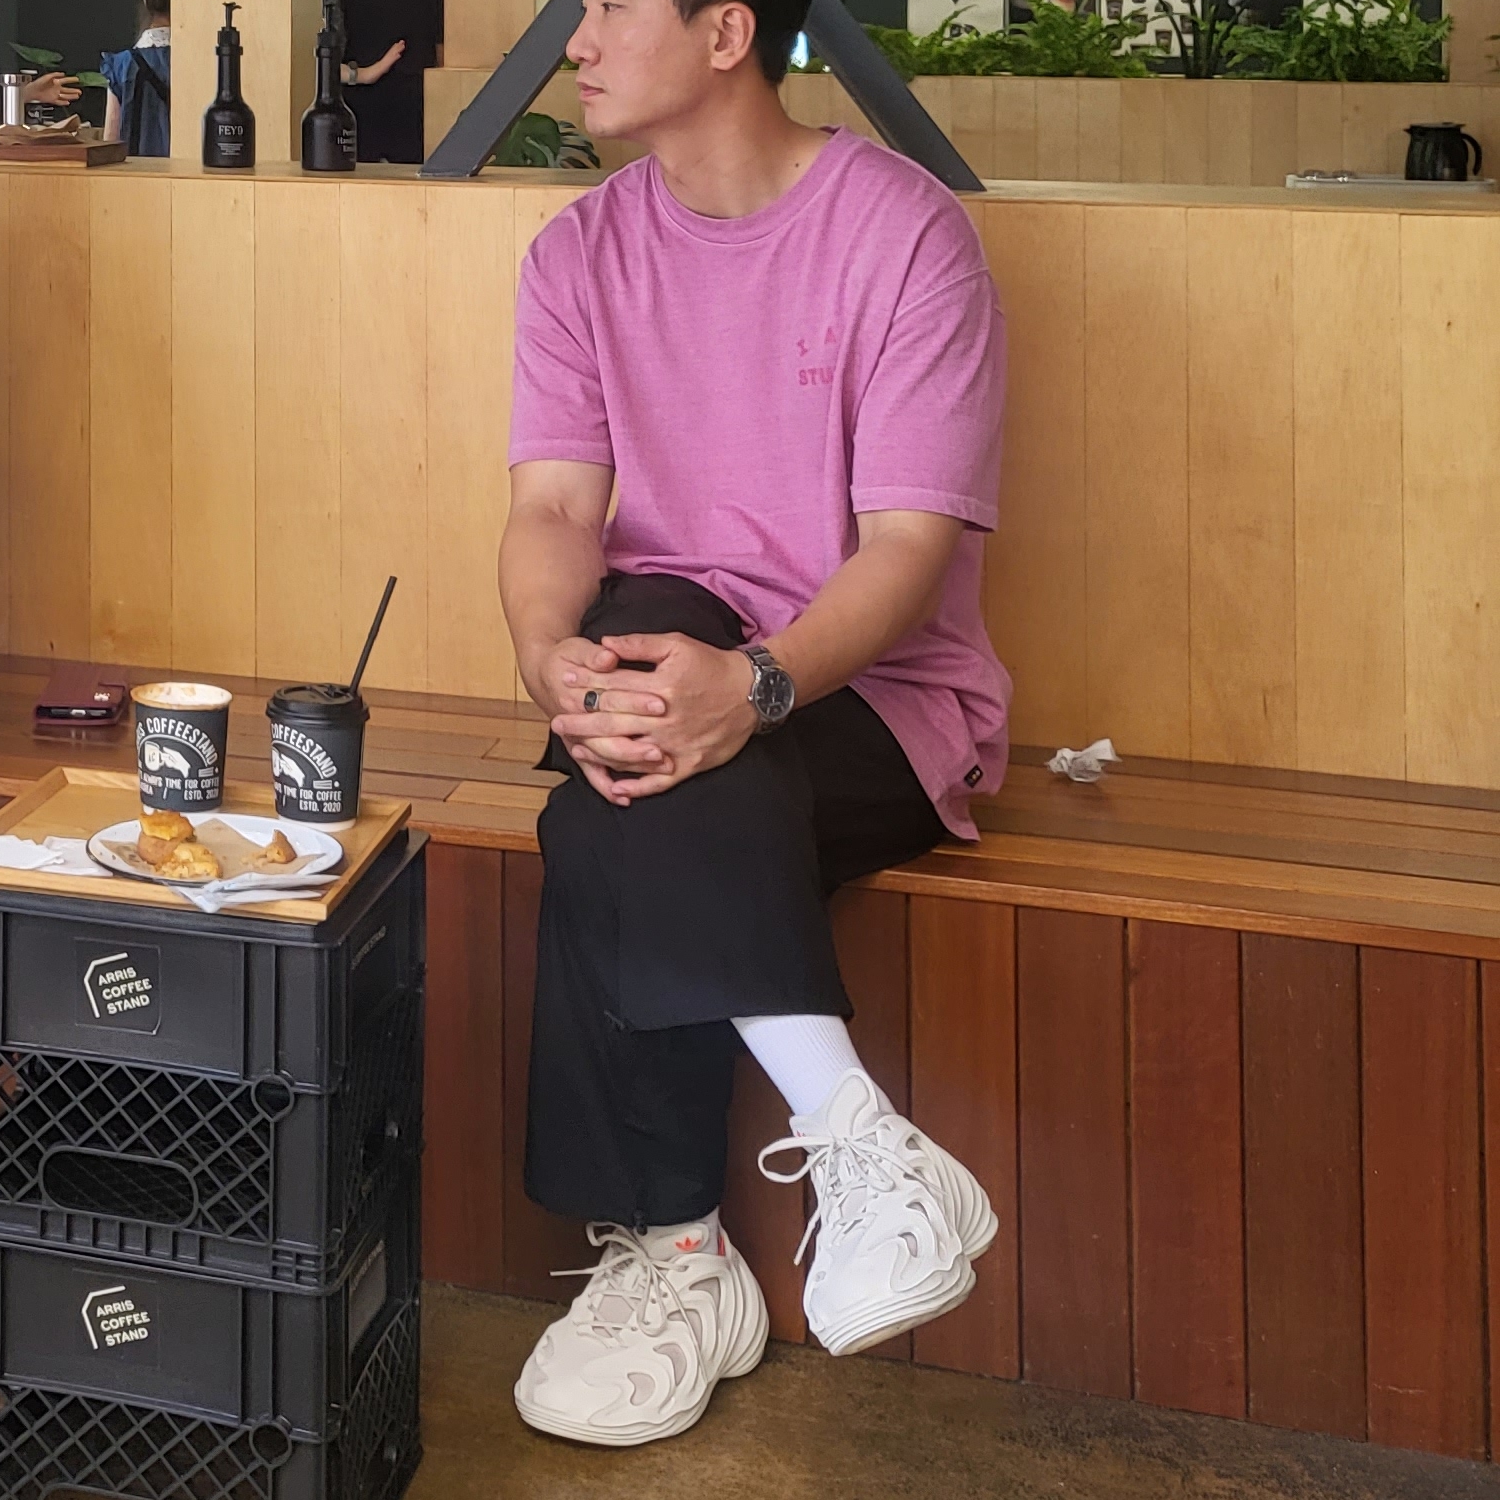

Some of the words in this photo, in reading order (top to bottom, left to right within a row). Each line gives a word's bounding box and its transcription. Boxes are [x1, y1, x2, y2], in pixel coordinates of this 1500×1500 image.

[145, 716, 219, 767] COFFEESTAND
[270, 723, 338, 779] COFFEESTAND
[165, 776, 182, 791] TIME
[184, 778, 199, 790] FOR
[300, 788, 314, 801] FOR
[316, 790, 343, 802] COFFEE
[322, 801, 341, 813] 2020
[98, 966, 137, 987] ARRIS
[102, 978, 153, 1001] COFFEE
[106, 994, 151, 1015] STAND
[96, 1299, 135, 1318] ARRIS
[100, 1311, 151, 1332] COFFEE
[105, 1327, 149, 1347] STAND
